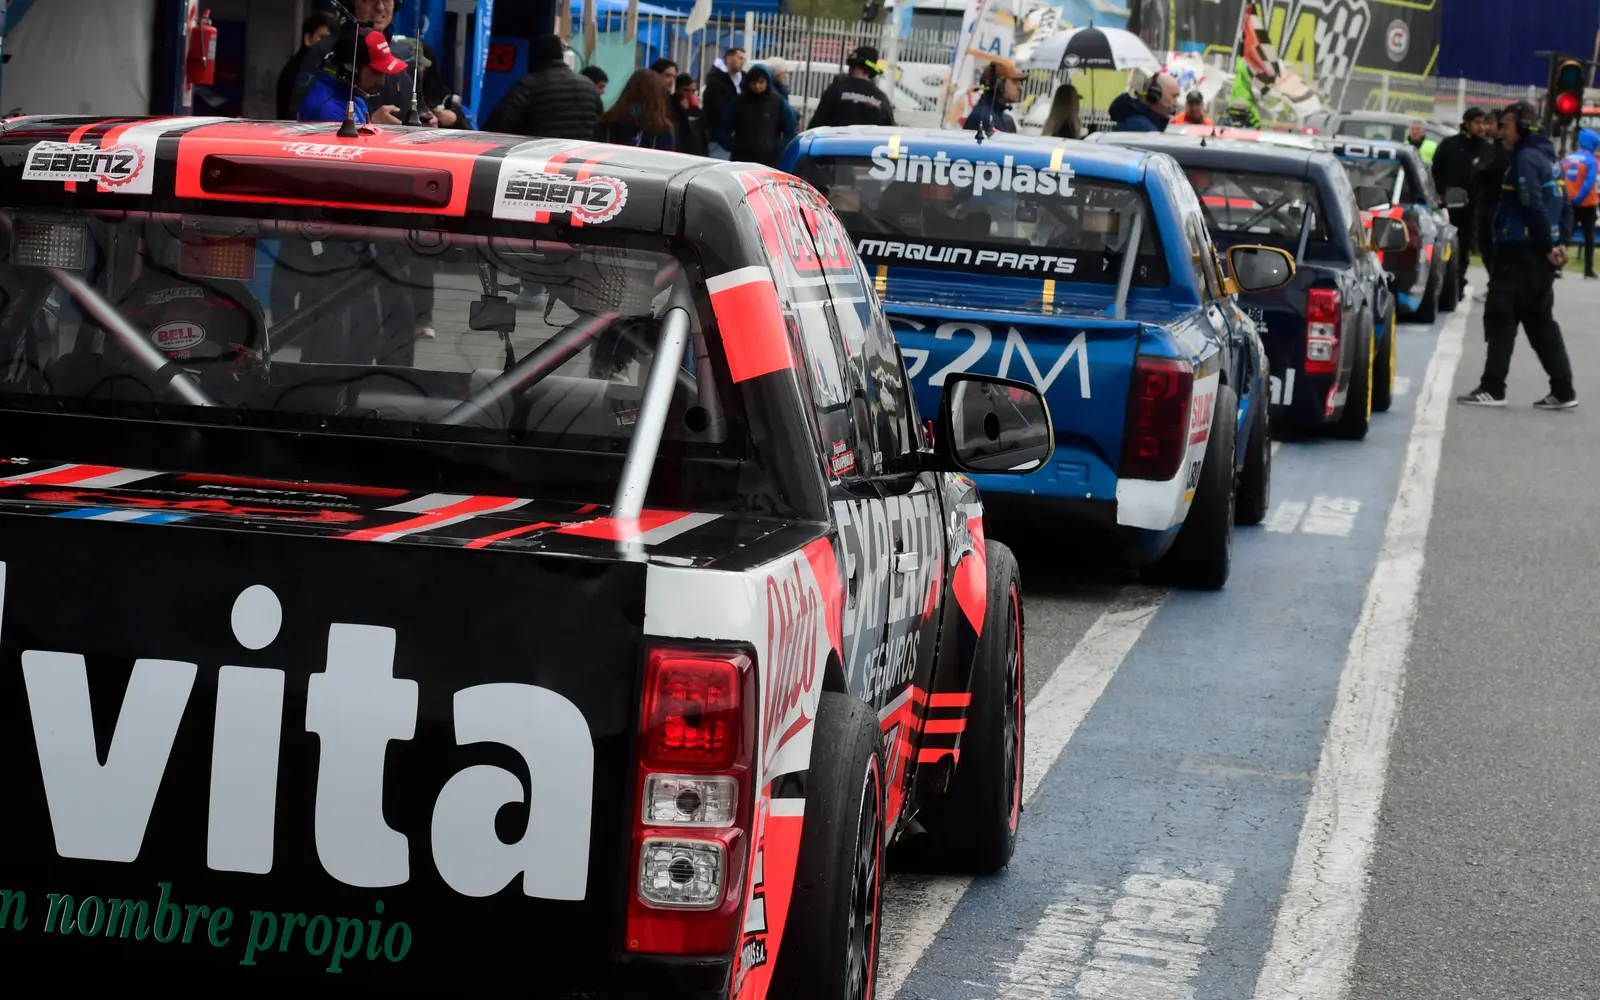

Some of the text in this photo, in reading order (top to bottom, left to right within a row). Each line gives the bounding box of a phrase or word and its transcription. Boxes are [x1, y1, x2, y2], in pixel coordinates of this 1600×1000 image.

[868, 144, 1076, 198] Sinteplast
[857, 238, 1078, 275] MAQUIN PARTS
[157, 327, 200, 343] BELL
[833, 494, 943, 640] EXPERTA
[860, 629, 921, 703] SEGUROS
[0, 559, 594, 900] vita
[44, 882, 235, 948] nombre
[240, 900, 413, 974] propio
